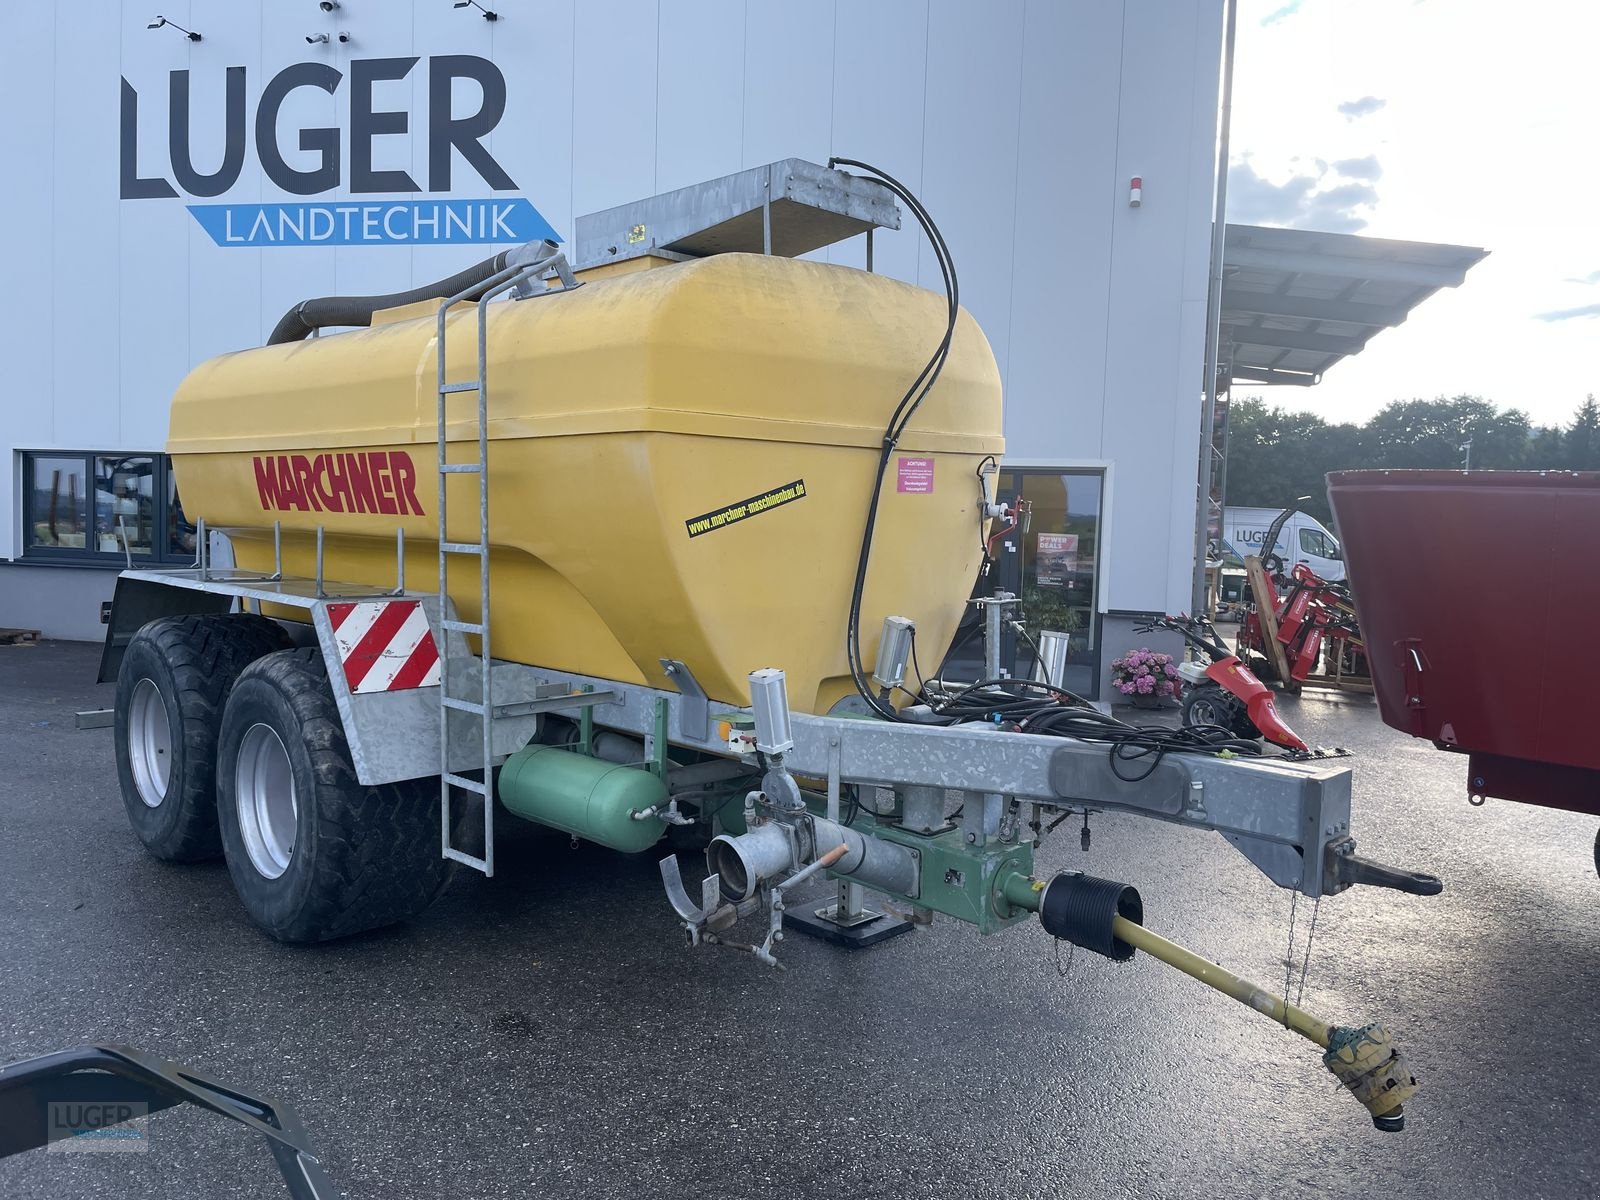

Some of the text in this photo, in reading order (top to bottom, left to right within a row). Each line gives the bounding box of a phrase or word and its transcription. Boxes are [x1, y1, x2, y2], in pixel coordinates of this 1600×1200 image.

[120, 55, 519, 199] LUGER
[225, 204, 518, 242] LANDTECHNIK
[252, 450, 426, 516] MARCHNER
[688, 483, 806, 535] www.marchner-maschinenbau.de
[1236, 529, 1279, 545] LUGE
